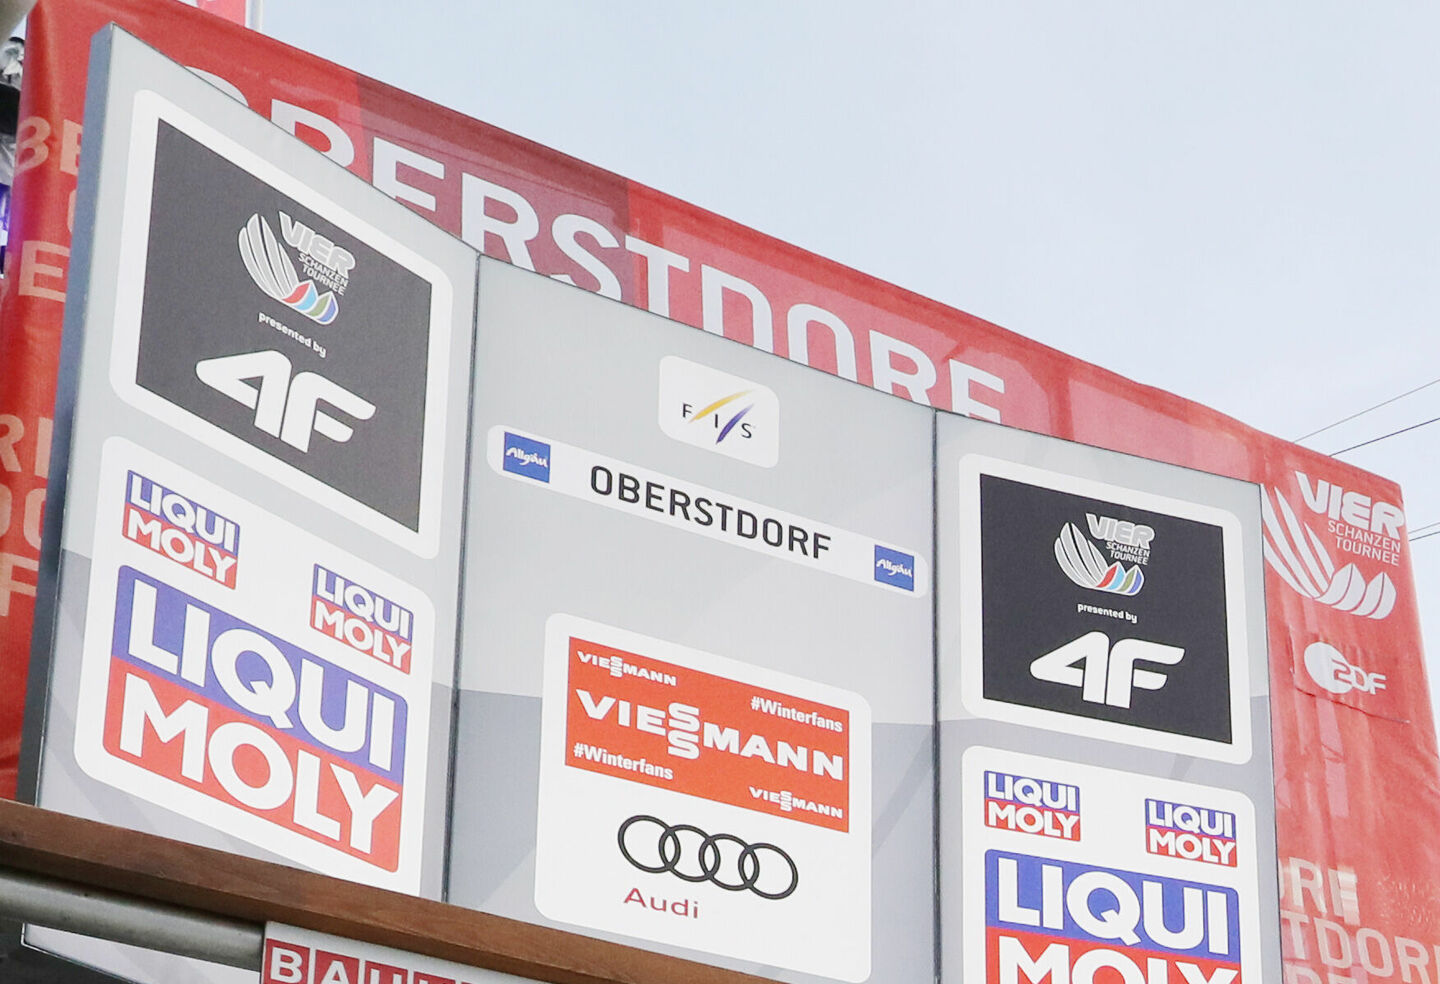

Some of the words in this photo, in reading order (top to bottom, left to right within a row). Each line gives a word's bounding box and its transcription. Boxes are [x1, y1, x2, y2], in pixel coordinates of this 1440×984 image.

[279, 211, 356, 278] VIER
[298, 253, 349, 287] SCHANZEN
[302, 264, 347, 296] TOURNEE
[258, 312, 312, 348] presented
[313, 341, 327, 358] by
[195, 350, 377, 453] 4F
[129, 474, 237, 553] LIQUI
[590, 464, 832, 560] OBERSTDORF
[1295, 470, 1405, 540] VIER
[127, 513, 237, 584] MOLY
[1086, 513, 1155, 549] VIER
[1106, 541, 1150, 557] SCHANZEN
[1327, 520, 1401, 553] SCHANZEN
[1110, 550, 1149, 565] TOURNEE
[1335, 535, 1399, 567] TOURNEE
[315, 567, 412, 640] LIQUI
[1077, 603, 1124, 619] presented
[1125, 611, 1138, 624] by
[314, 600, 412, 671] MOLY
[128, 580, 395, 772] LIQUI
[576, 651, 677, 686] VIESSMANN
[1030, 630, 1185, 709] 4F
[750, 695, 843, 733] #Winterfans
[575, 688, 844, 781] VIESSMANN
[119, 673, 400, 855] MOLY
[573, 742, 674, 780] #Winterfans
[748, 786, 843, 819] VIESSMANN
[988, 772, 1077, 811] LIQUI
[988, 803, 1079, 840] MOLY
[1148, 801, 1234, 837] LIQUI
[1149, 828, 1236, 866] MOLY
[623, 887, 700, 920] Audi
[998, 857, 1229, 956] LIQUI
